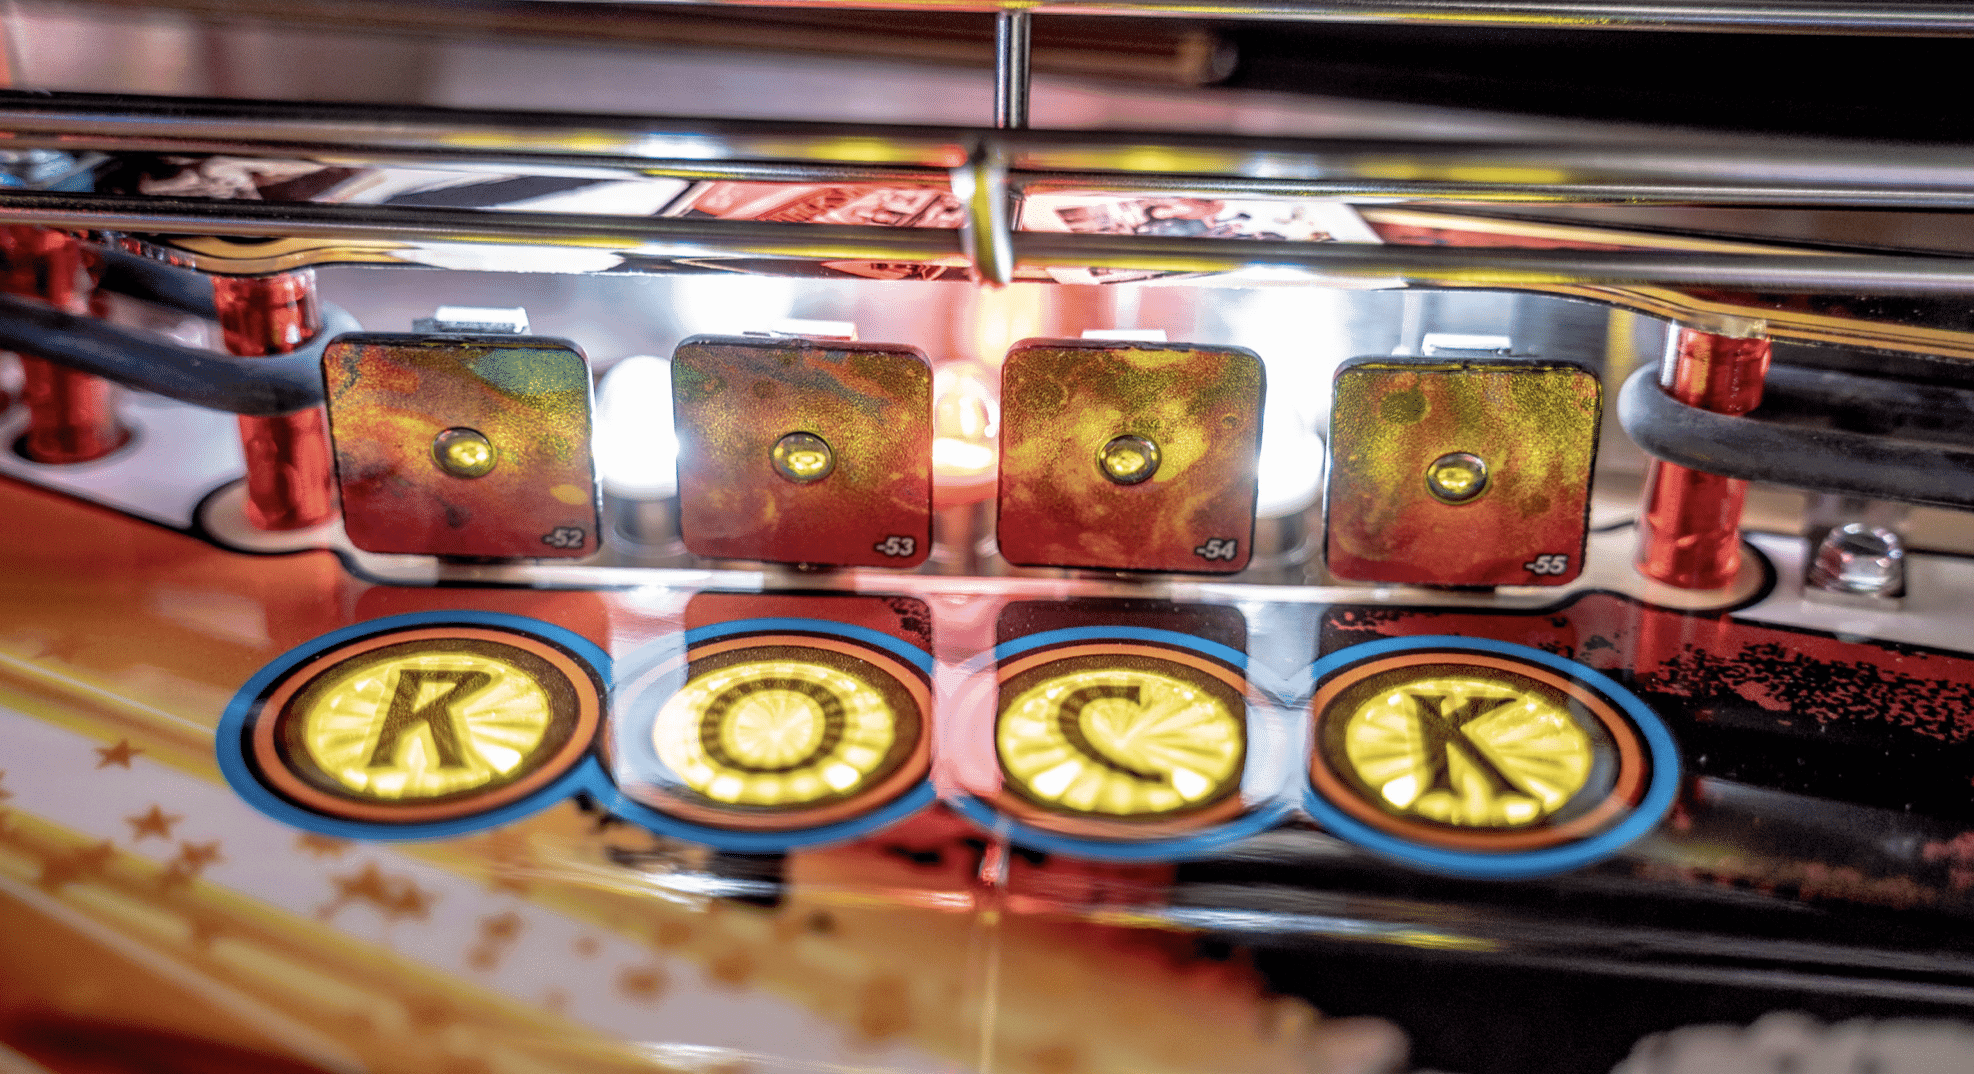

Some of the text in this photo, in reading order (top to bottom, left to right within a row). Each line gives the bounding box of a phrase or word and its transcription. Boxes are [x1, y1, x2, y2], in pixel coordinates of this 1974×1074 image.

[543, 528, 584, 548] -52
[874, 536, 915, 556] -53
[1195, 539, 1236, 560] -54
[1525, 554, 1568, 575] -55
